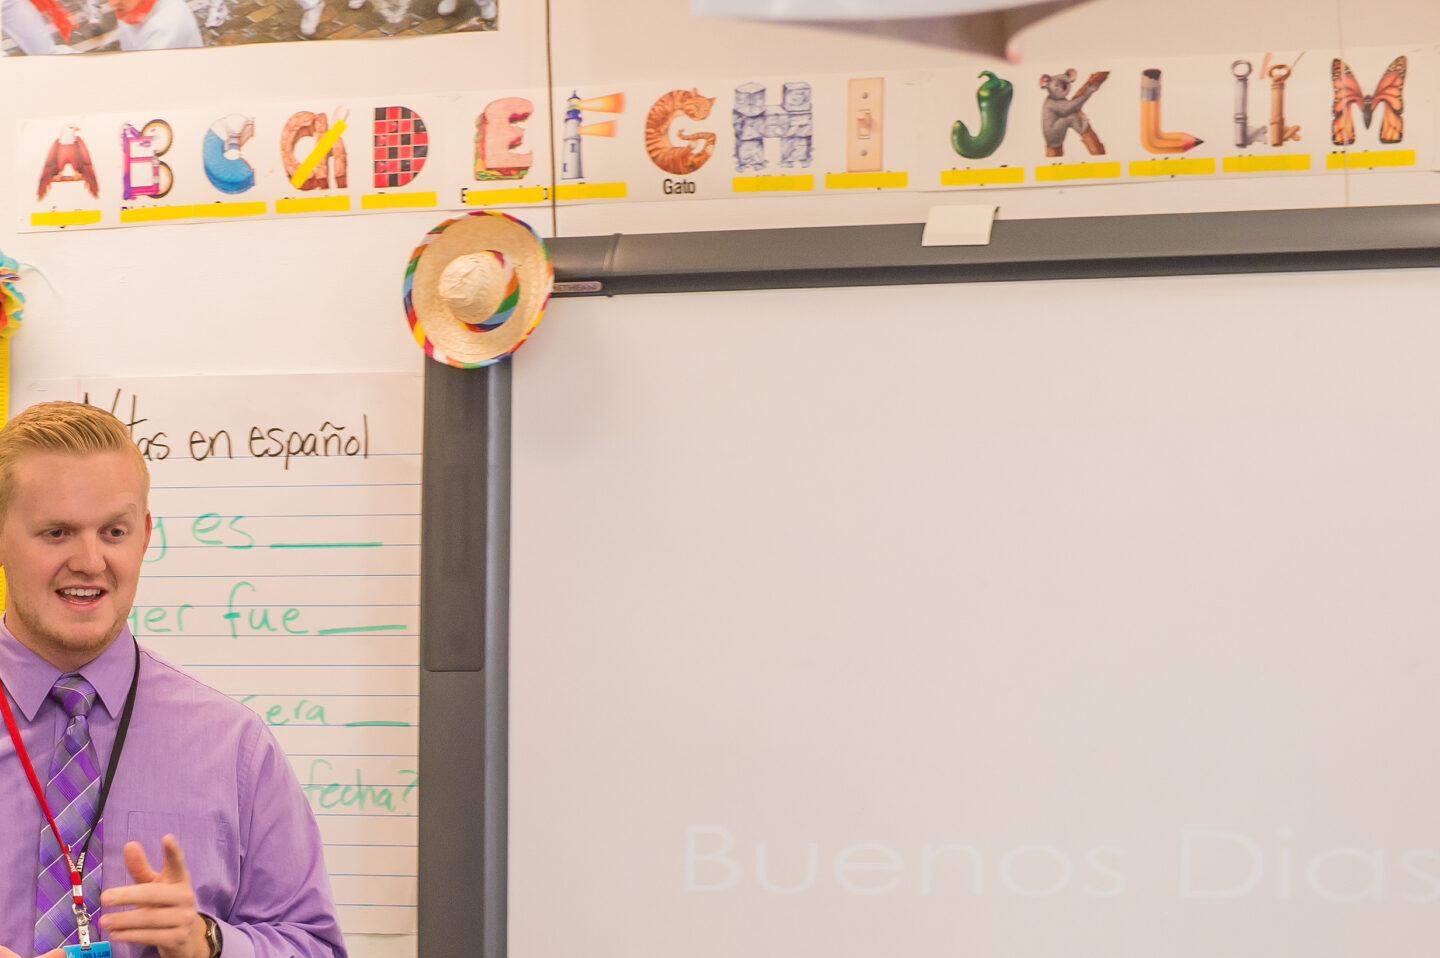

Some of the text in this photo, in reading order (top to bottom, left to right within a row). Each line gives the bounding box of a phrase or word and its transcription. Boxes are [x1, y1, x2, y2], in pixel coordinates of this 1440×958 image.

[663, 178, 697, 196] Gato
[190, 429, 233, 461] en
[249, 414, 369, 470] español
[192, 512, 255, 550] es
[223, 581, 309, 639] fue
[682, 824, 1126, 898] Buenos
